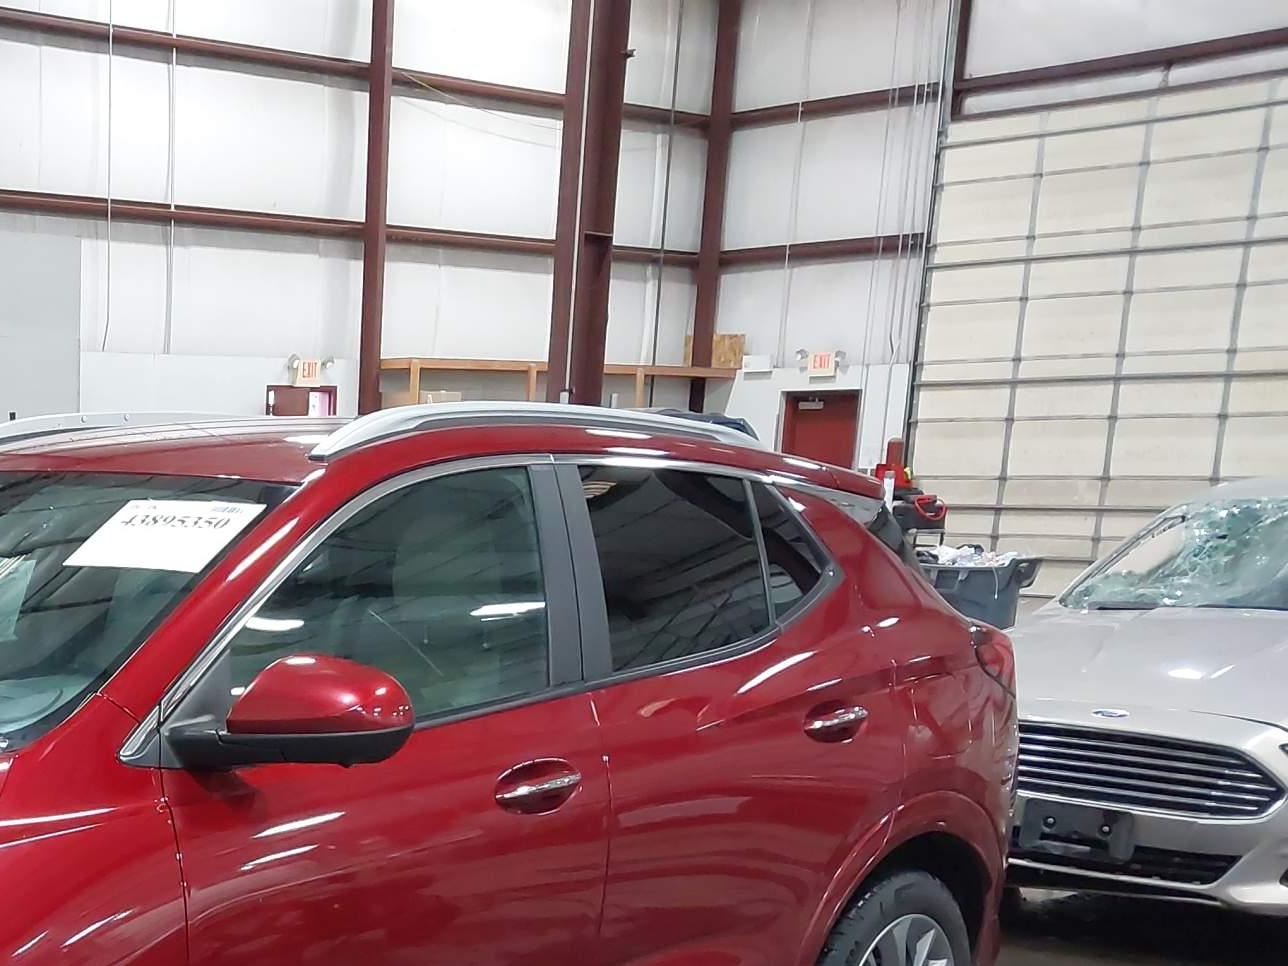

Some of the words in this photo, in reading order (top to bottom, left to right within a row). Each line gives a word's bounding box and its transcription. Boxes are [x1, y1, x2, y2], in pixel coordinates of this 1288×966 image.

[813, 353, 831, 369] EXIT
[302, 361, 318, 378] EXIT
[121, 514, 231, 529] 43895350
